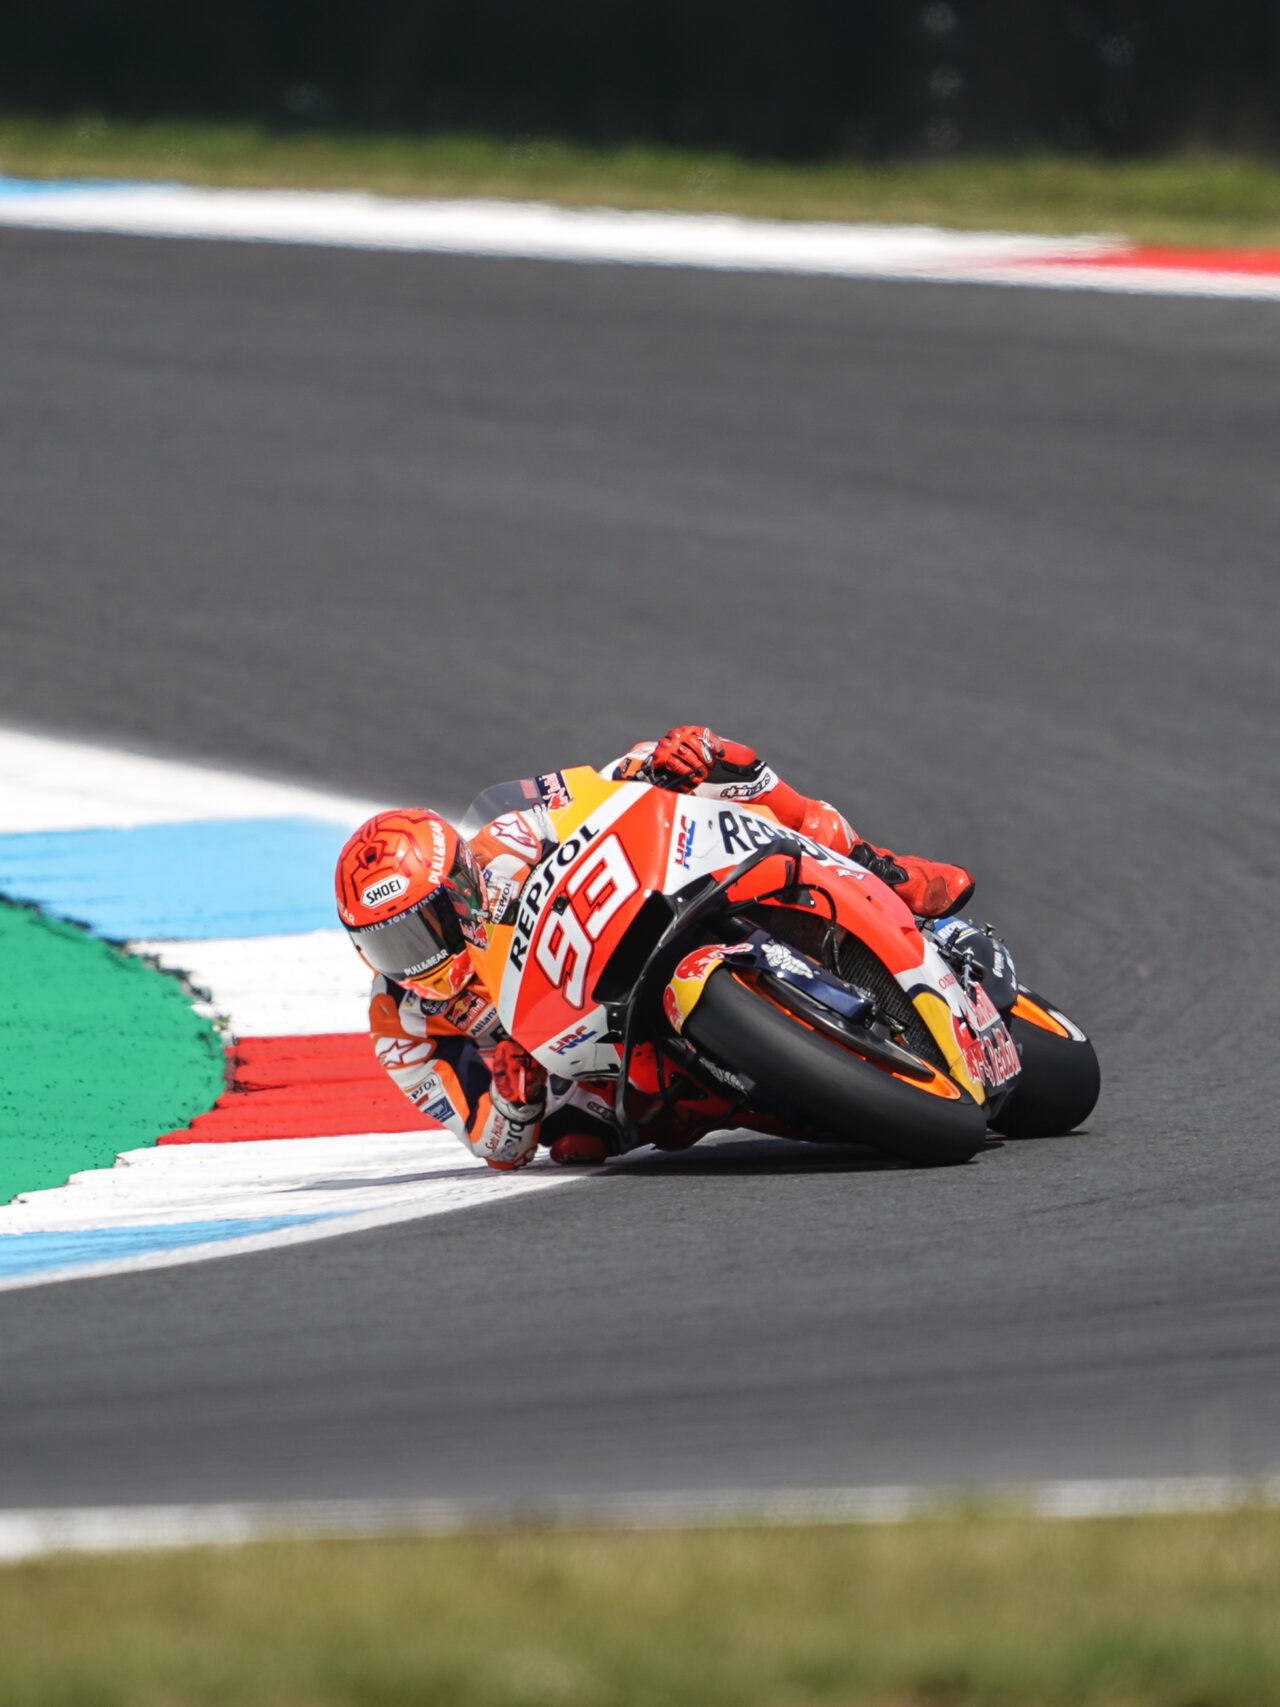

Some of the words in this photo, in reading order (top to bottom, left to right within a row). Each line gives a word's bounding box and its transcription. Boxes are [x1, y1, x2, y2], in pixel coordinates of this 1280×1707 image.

[428, 820, 446, 885] PULL&BEAR
[365, 879, 402, 905] SHOEI
[493, 881, 513, 924] REPSOL
[509, 824, 600, 973] REPSOL
[534, 832, 641, 1010] 93
[404, 948, 449, 976] PULL&BEAR
[548, 1025, 598, 1056] HRC
